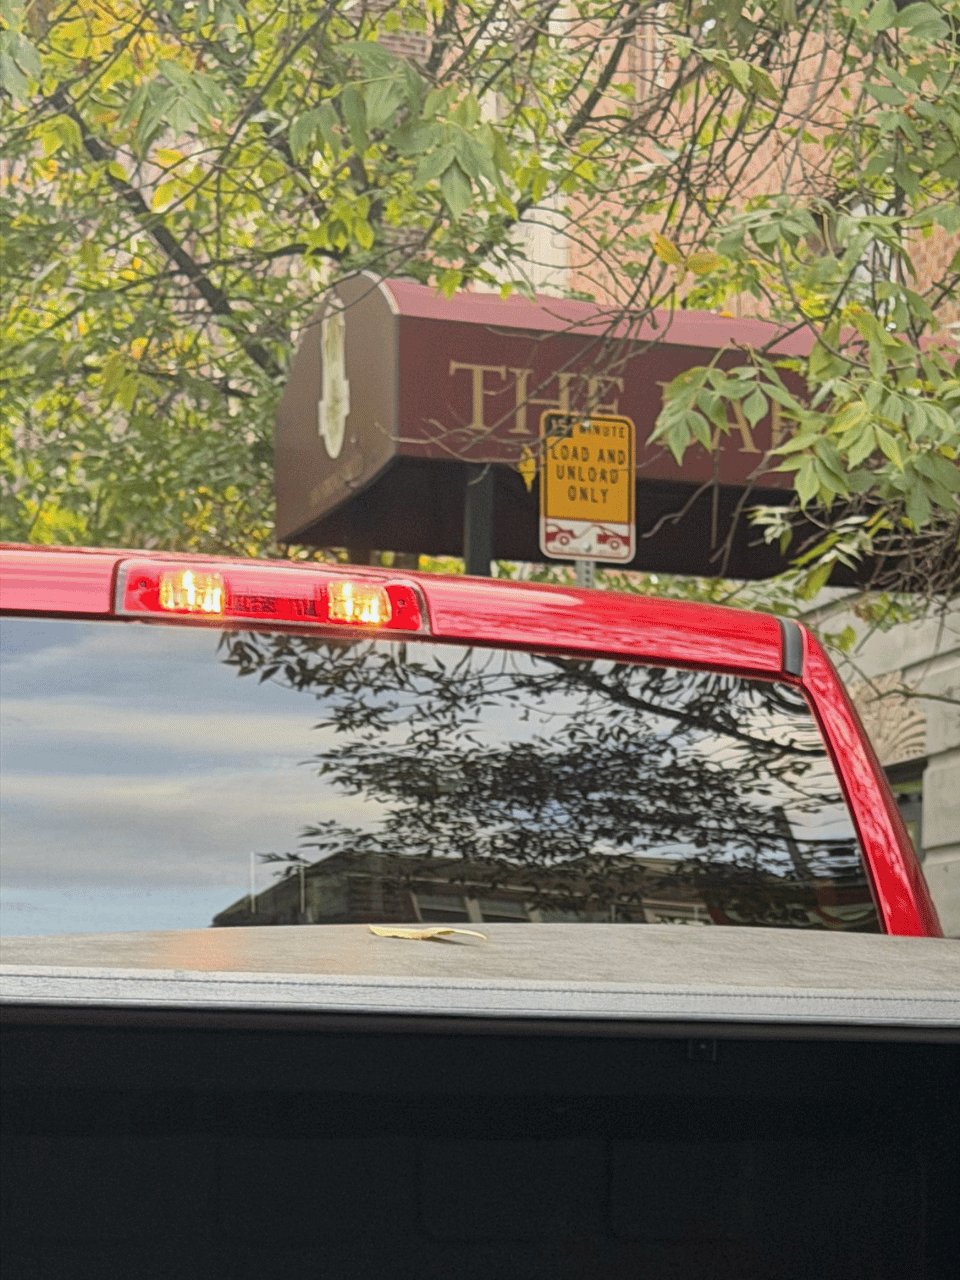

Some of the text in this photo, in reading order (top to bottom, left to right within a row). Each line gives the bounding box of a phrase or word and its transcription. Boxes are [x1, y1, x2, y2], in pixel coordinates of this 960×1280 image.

[449, 360, 625, 435] THE
[551, 445, 626, 465] LOAD AND
[556, 464, 619, 484] UNLOAD
[567, 485, 609, 504] ONLY
